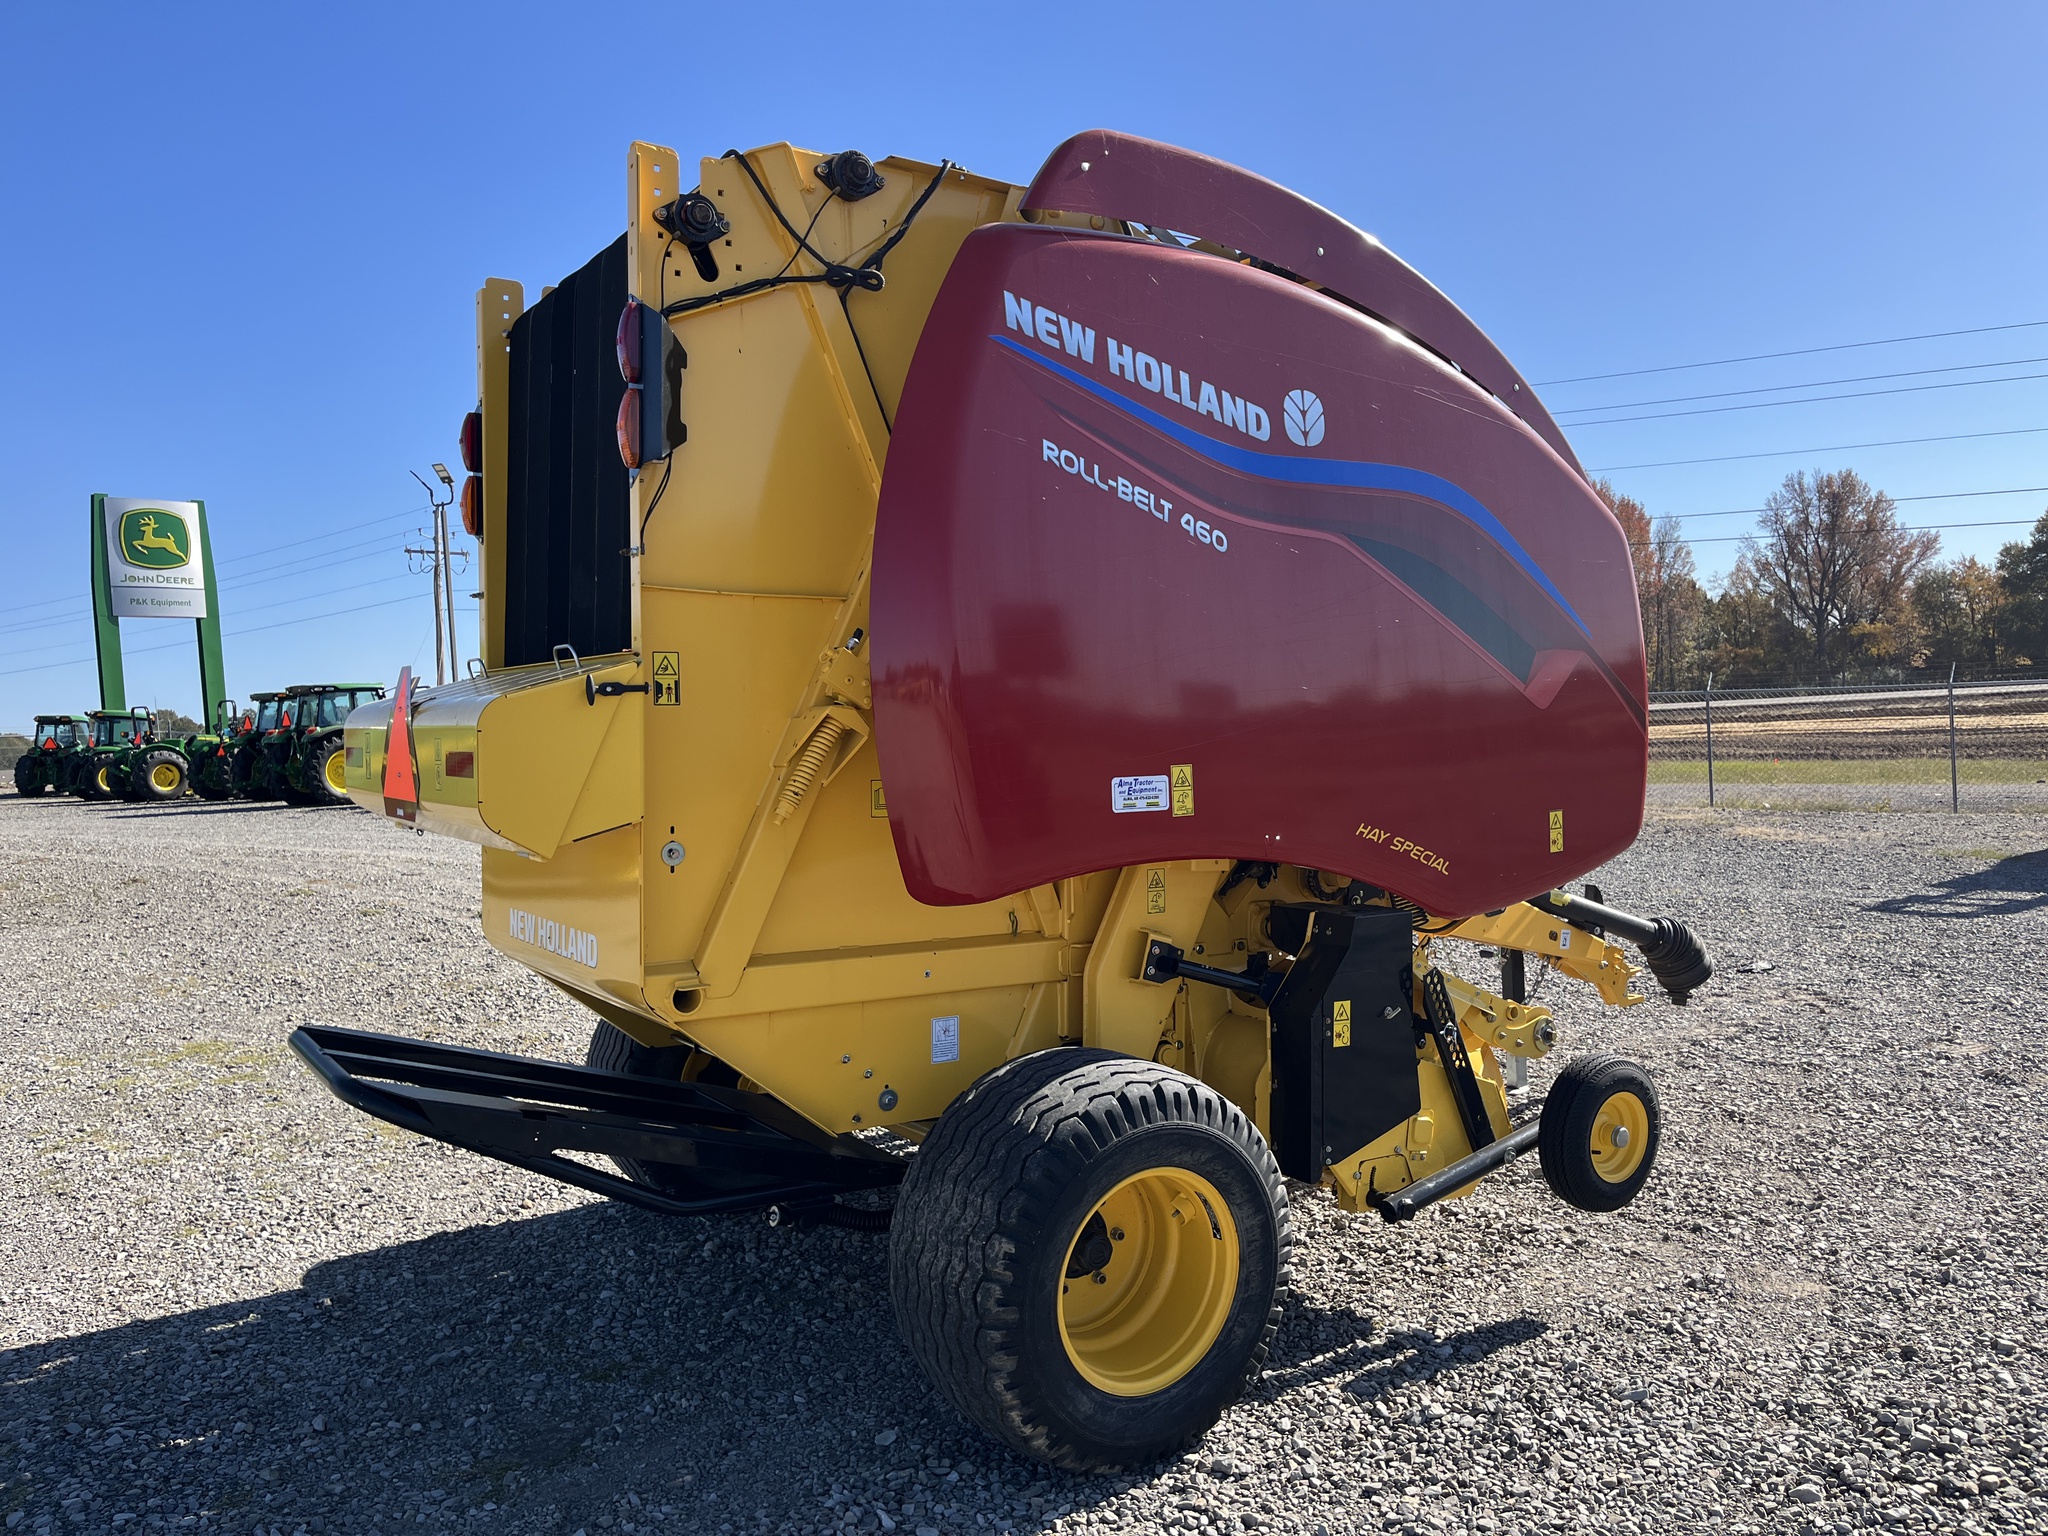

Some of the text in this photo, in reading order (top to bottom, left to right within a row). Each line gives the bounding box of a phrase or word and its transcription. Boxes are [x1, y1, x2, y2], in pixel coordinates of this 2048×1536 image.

[1003, 290, 1271, 442] NEW HOLLAND
[1042, 438, 1228, 553] ROLL-BELT 460
[120, 573, 195, 585] JOHN DEERE
[129, 597, 192, 608] P&K Equipment
[1117, 778, 1154, 788] Alma Tractor
[1127, 786, 1157, 796] Equipment
[1355, 822, 1450, 876] HAY SPECIAL
[509, 907, 598, 969] NEW HOLLAND
